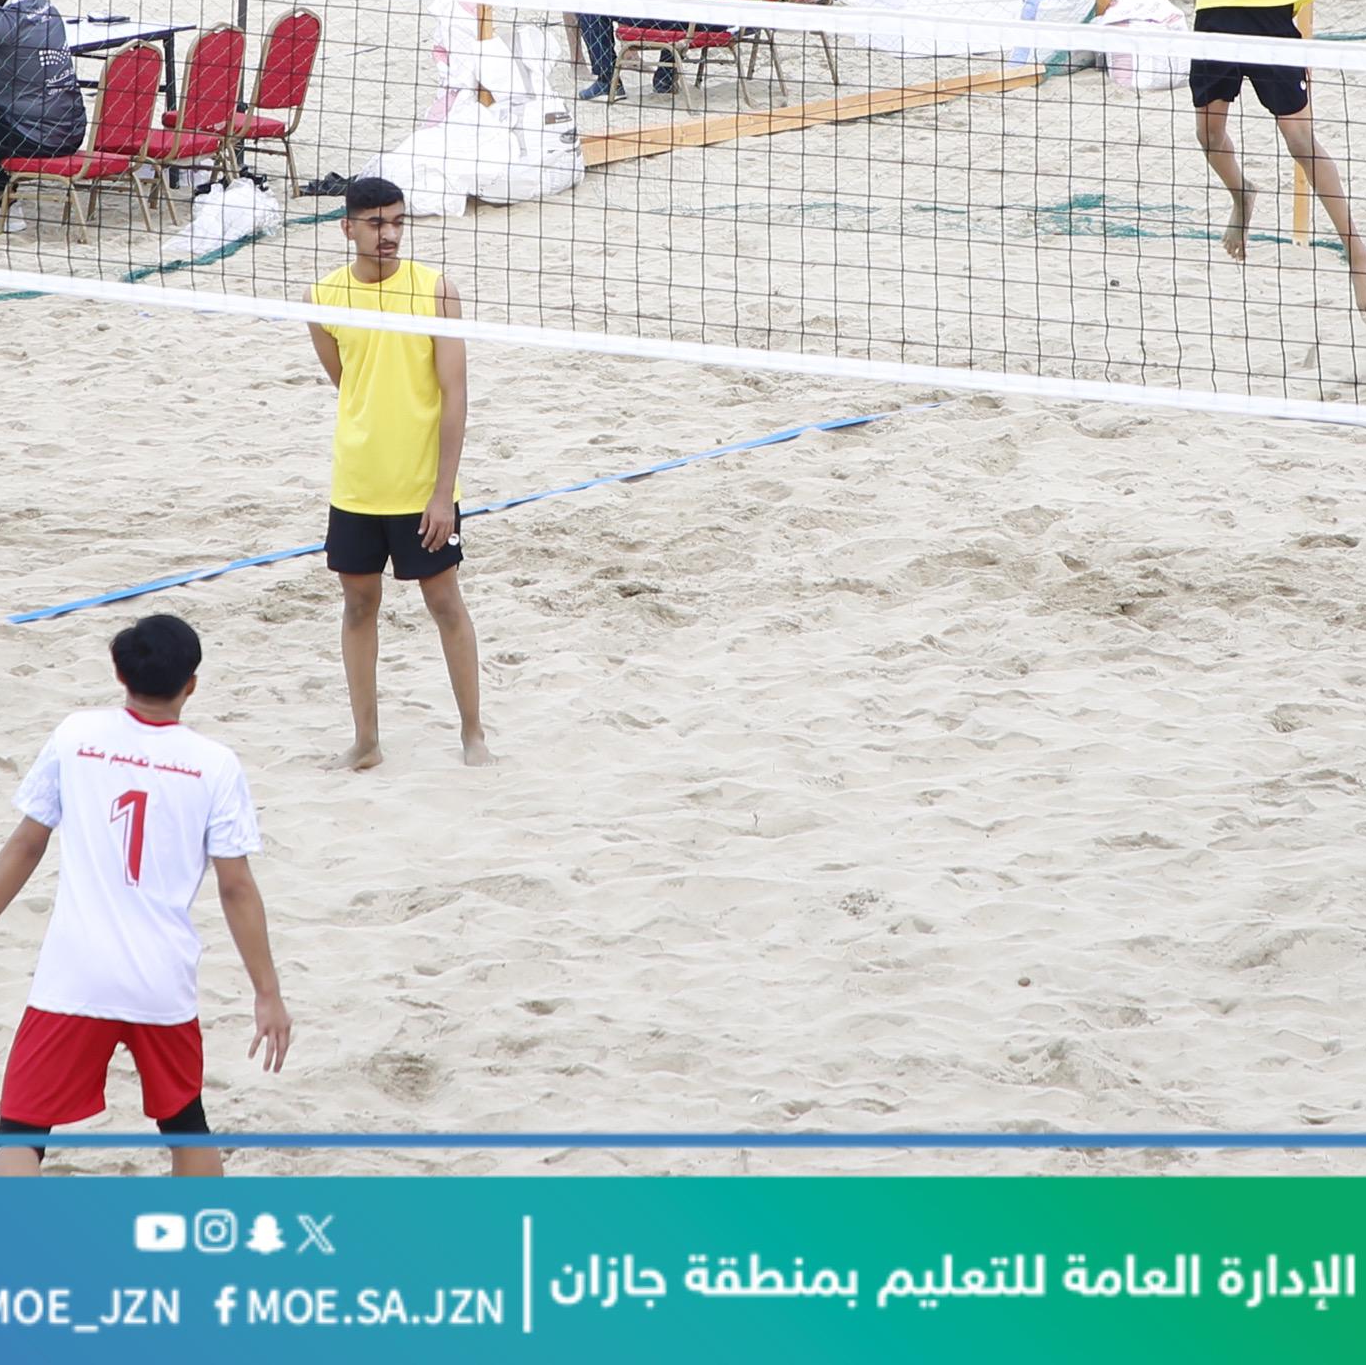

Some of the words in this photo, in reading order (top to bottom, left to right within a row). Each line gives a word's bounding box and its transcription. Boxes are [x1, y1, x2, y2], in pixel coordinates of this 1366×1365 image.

[108, 753, 150, 768] تعليم
[153, 759, 203, 779] منتخب
[109, 788, 148, 888] 1
